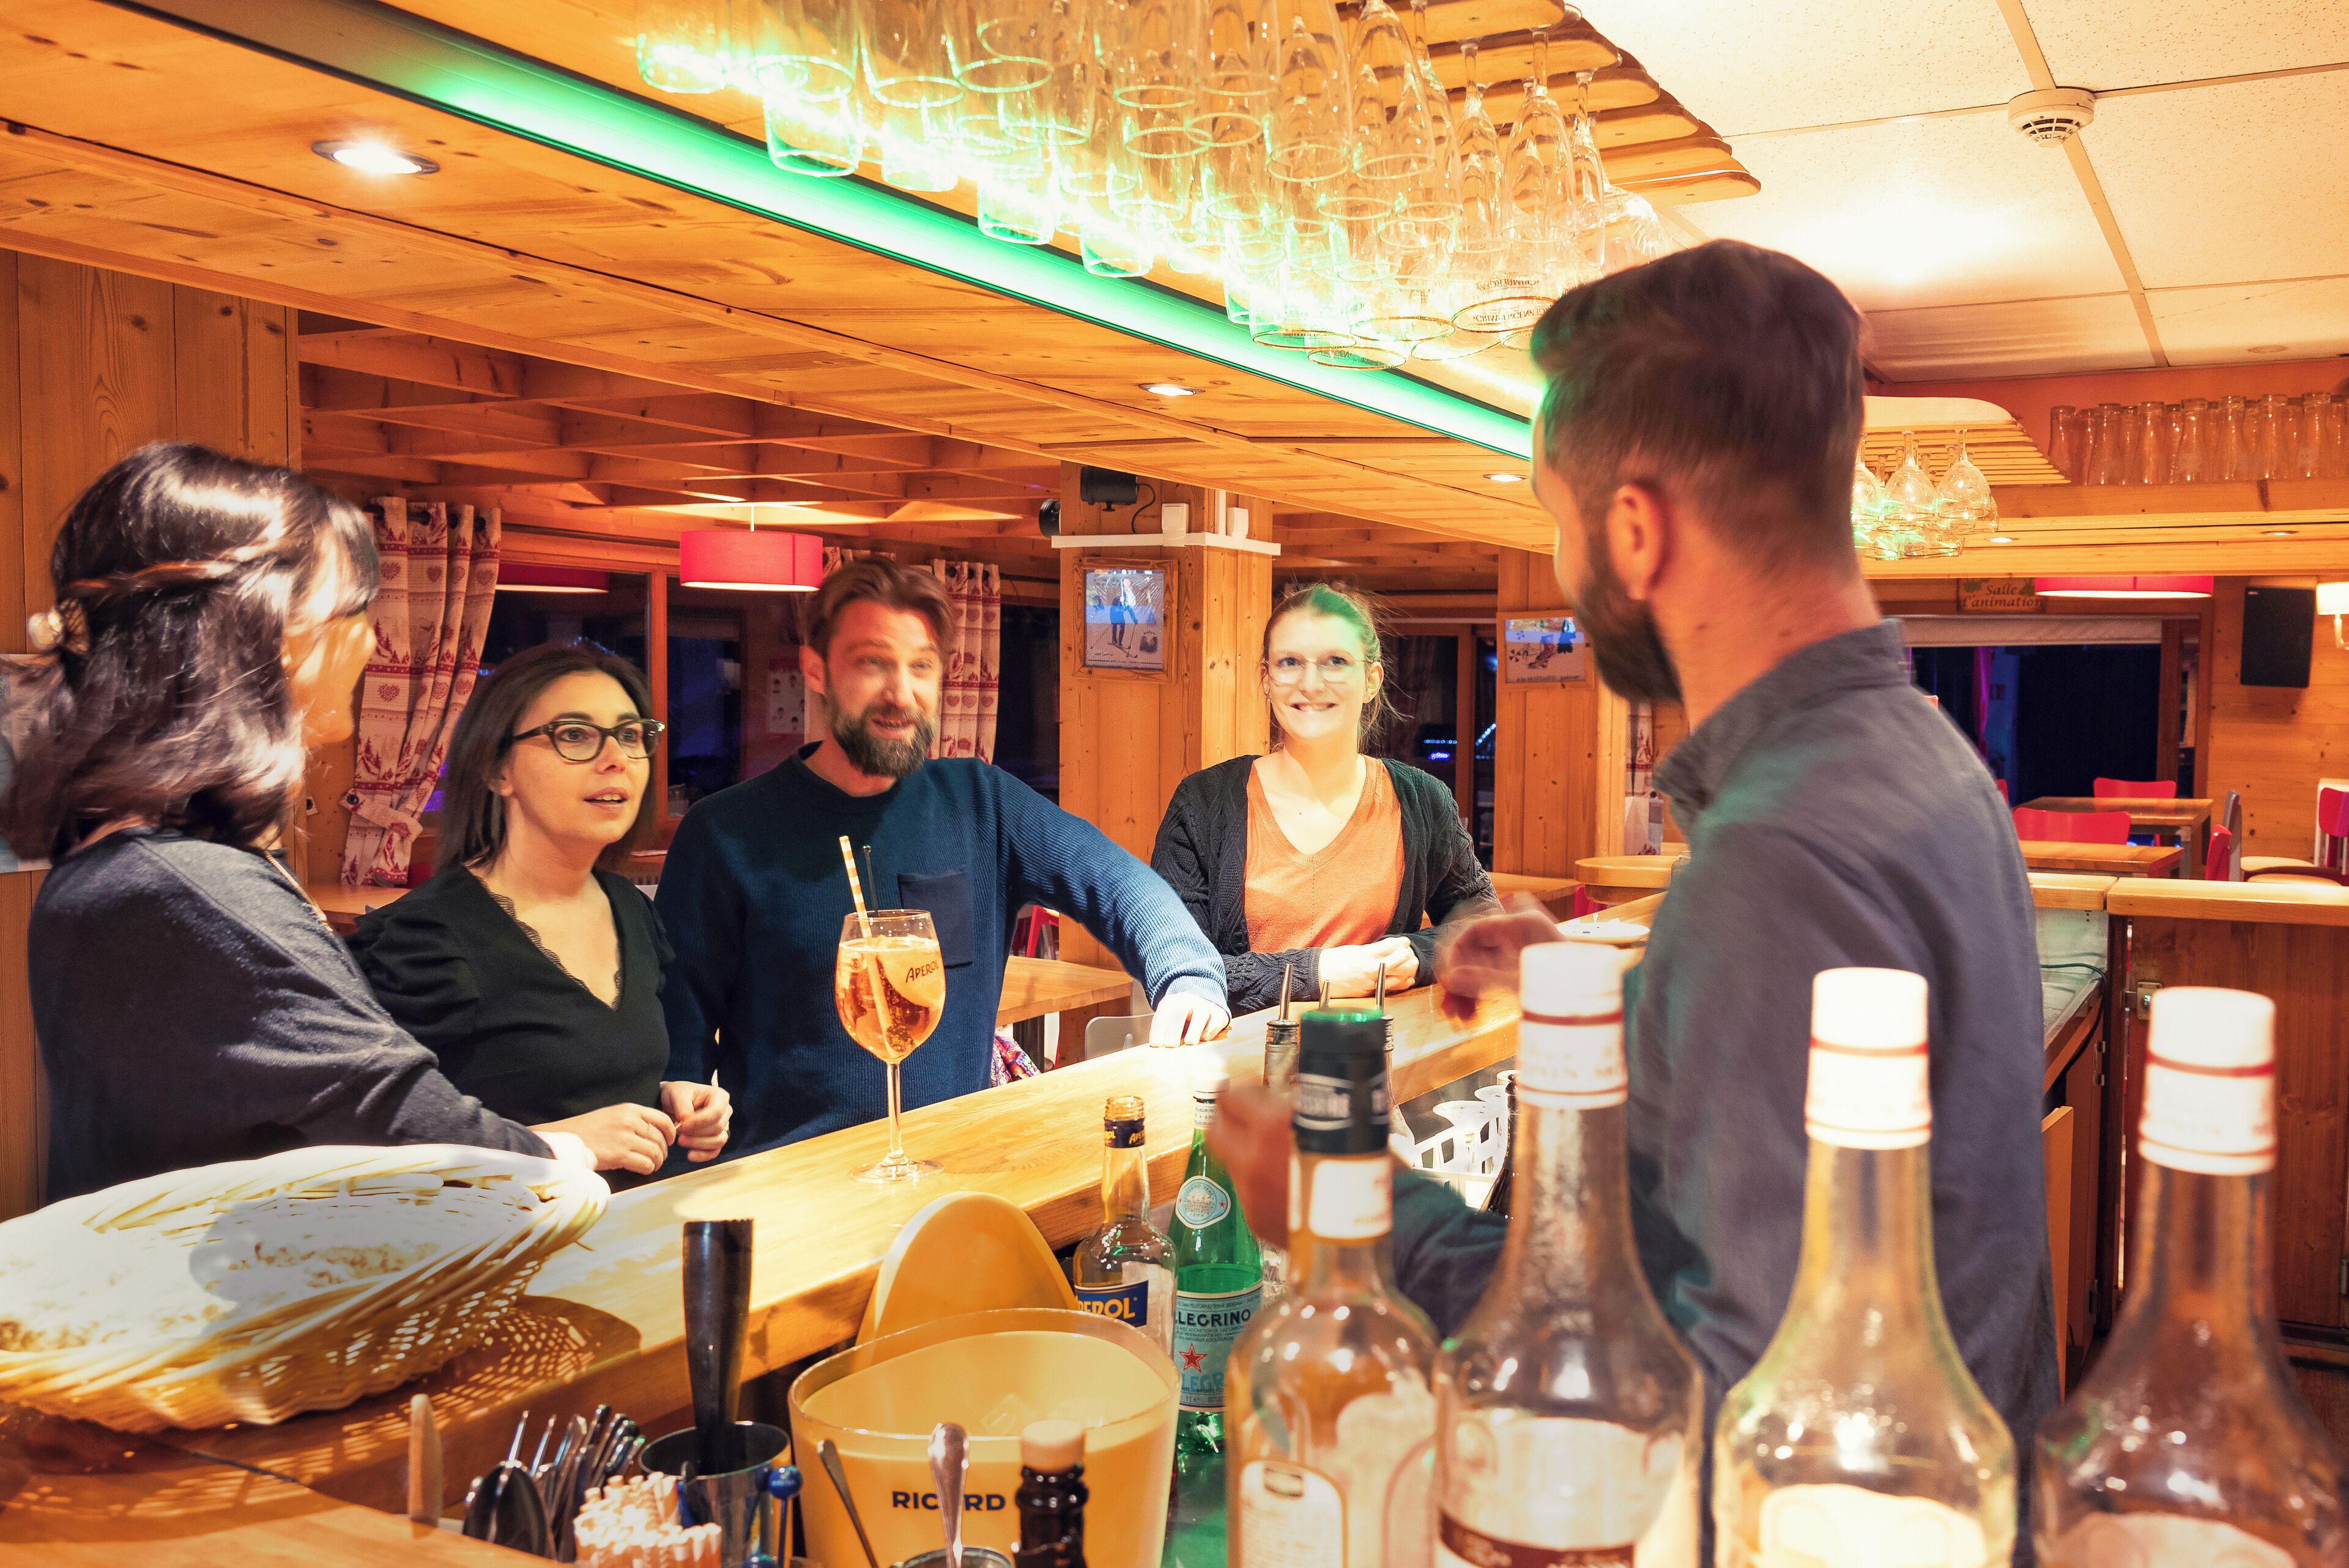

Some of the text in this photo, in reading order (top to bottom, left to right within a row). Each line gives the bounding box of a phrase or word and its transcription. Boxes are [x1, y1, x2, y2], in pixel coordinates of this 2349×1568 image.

[1986, 583, 2017, 595] Salle
[1960, 593, 2043, 608] d'animation
[1075, 1295, 1136, 1319] PEROL
[1175, 1309, 1251, 1327] LEGRINO
[892, 1490, 1006, 1511] RICRD
